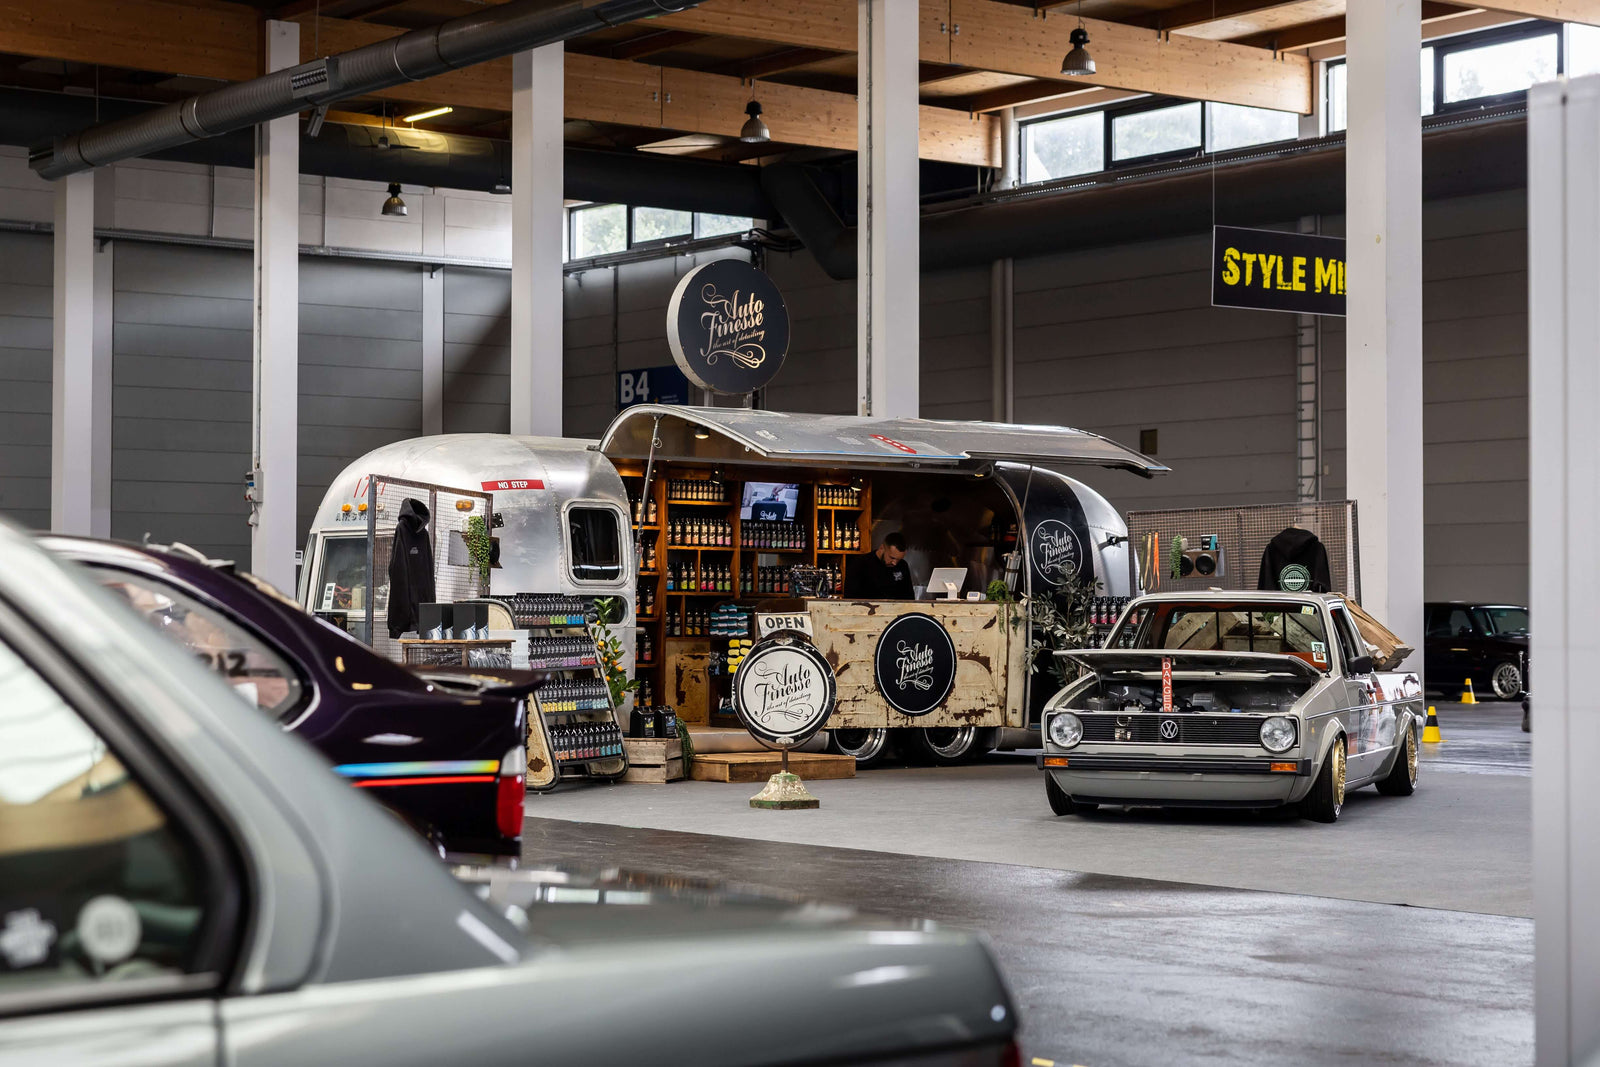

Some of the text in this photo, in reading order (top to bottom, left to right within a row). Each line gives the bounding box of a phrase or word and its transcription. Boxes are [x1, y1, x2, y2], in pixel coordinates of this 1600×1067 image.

[1222, 247, 1347, 295] STYLE MI
[711, 286, 765, 322] Auto
[700, 311, 764, 357] Finesse
[620, 371, 650, 403] B4
[497, 481, 509, 489] NO
[1042, 528, 1072, 547] Auto
[765, 616, 805, 629] OPEN
[902, 642, 933, 662] Auto
[763, 662, 811, 689] Auto
[1162, 661, 1171, 712] DANGER
[755, 679, 811, 717] Finesse
